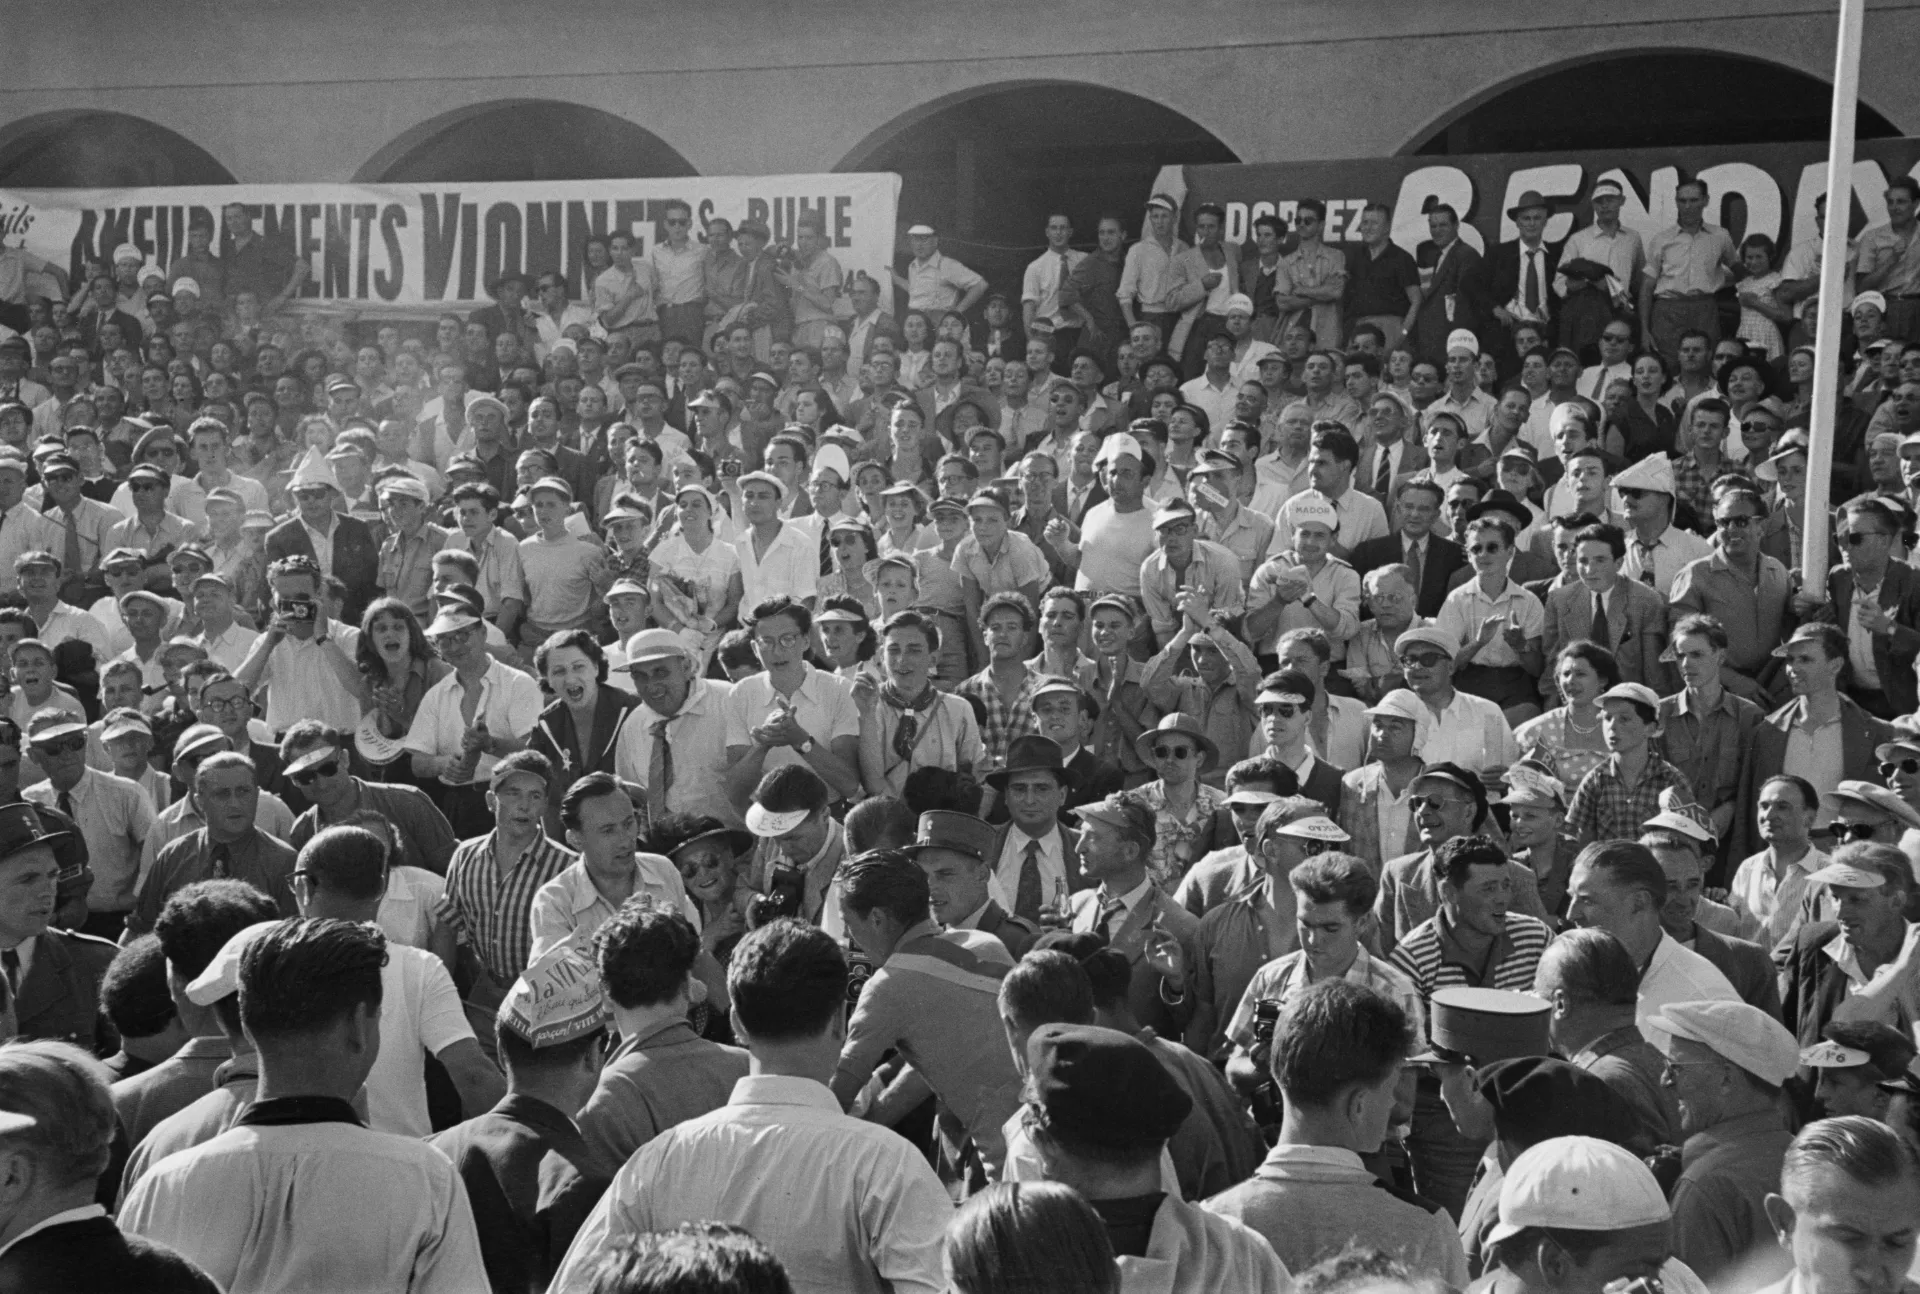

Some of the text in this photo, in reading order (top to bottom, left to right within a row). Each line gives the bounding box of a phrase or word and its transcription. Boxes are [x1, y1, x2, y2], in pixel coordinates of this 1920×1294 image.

[69, 203, 407, 301] AMEUENTS
[747, 196, 852, 249] BULE
[1194, 199, 1369, 246] DOPEZ
